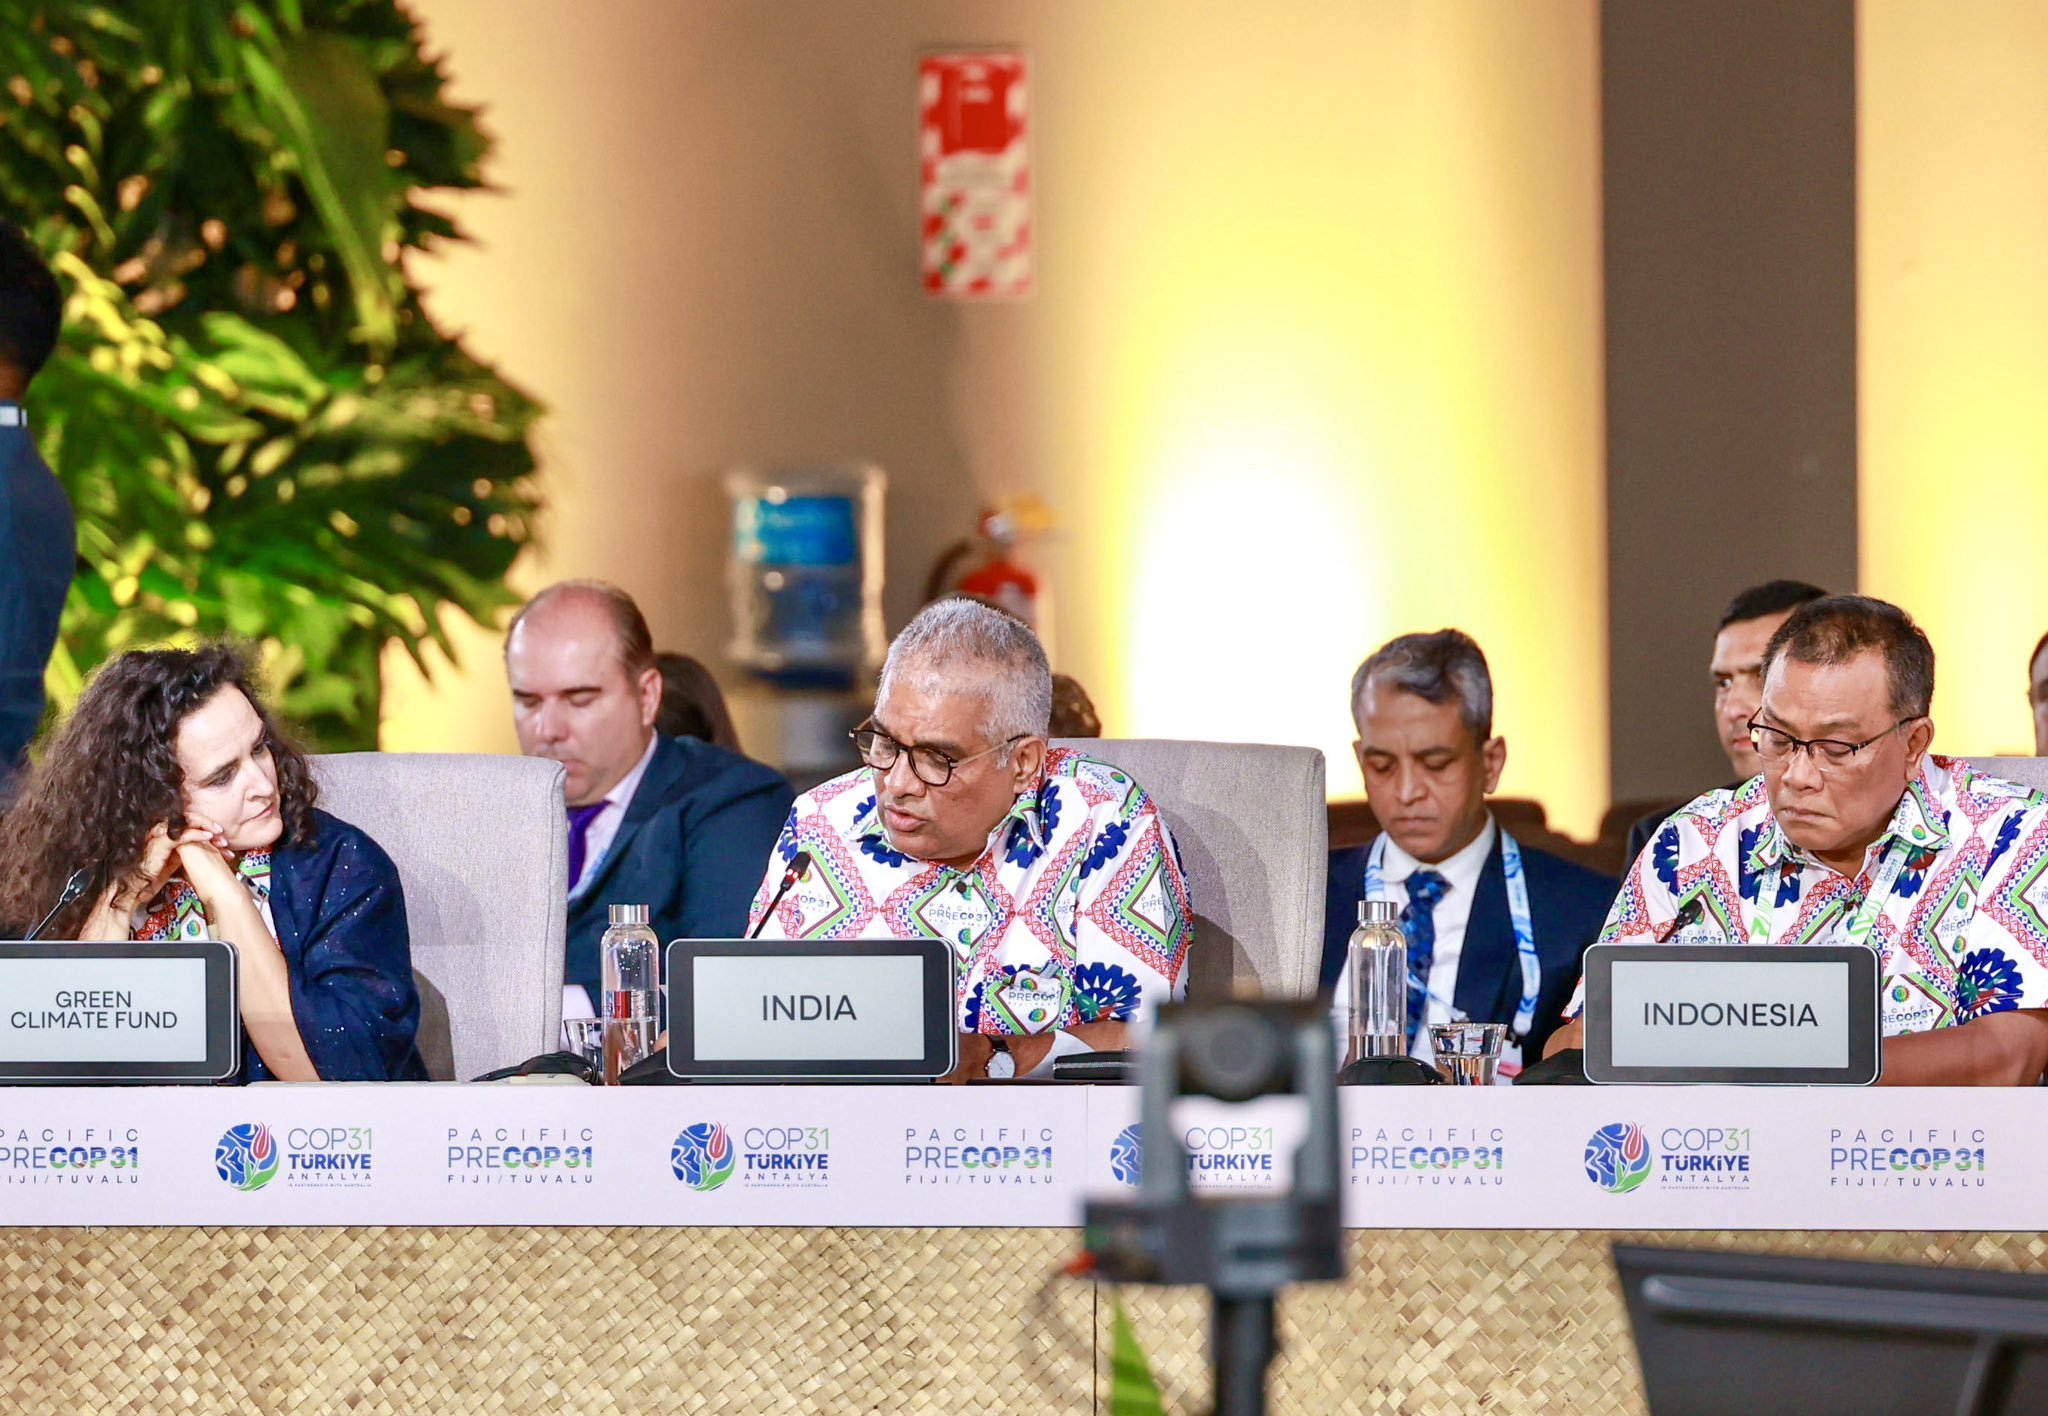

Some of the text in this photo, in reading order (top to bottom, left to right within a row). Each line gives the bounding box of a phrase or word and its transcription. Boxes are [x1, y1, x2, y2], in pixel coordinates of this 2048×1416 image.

[56, 991, 131, 1008] GREEN
[762, 994, 858, 1021] INDIA
[1644, 1002, 1819, 1027] INDONESIA
[11, 1011, 178, 1029] CLIMATE FUND
[1882, 1008, 1935, 1024] RECOP31
[287, 1127, 372, 1151] COP31
[448, 1128, 593, 1142] PACIFIC
[743, 1127, 829, 1151] COP31
[906, 1128, 1053, 1142] PACIFIC
[1185, 1127, 1273, 1151] COP31
[1351, 1128, 1503, 1142] PACIFIC
[1661, 1128, 1750, 1152] COP31
[1831, 1129, 1985, 1143] PACIFIC
[0, 1175, 138, 1184] IJI/TUVALU
[287, 1173, 372, 1181] ANTALYA
[448, 1175, 593, 1184] FIJI/TUVALU
[743, 1173, 829, 1181] ANTALYA
[906, 1175, 1053, 1184] FIJI/TUVALU
[1351, 1175, 1503, 1185] FIJI/TUVALU
[1831, 1177, 1985, 1187] FIJI/TUVALU
